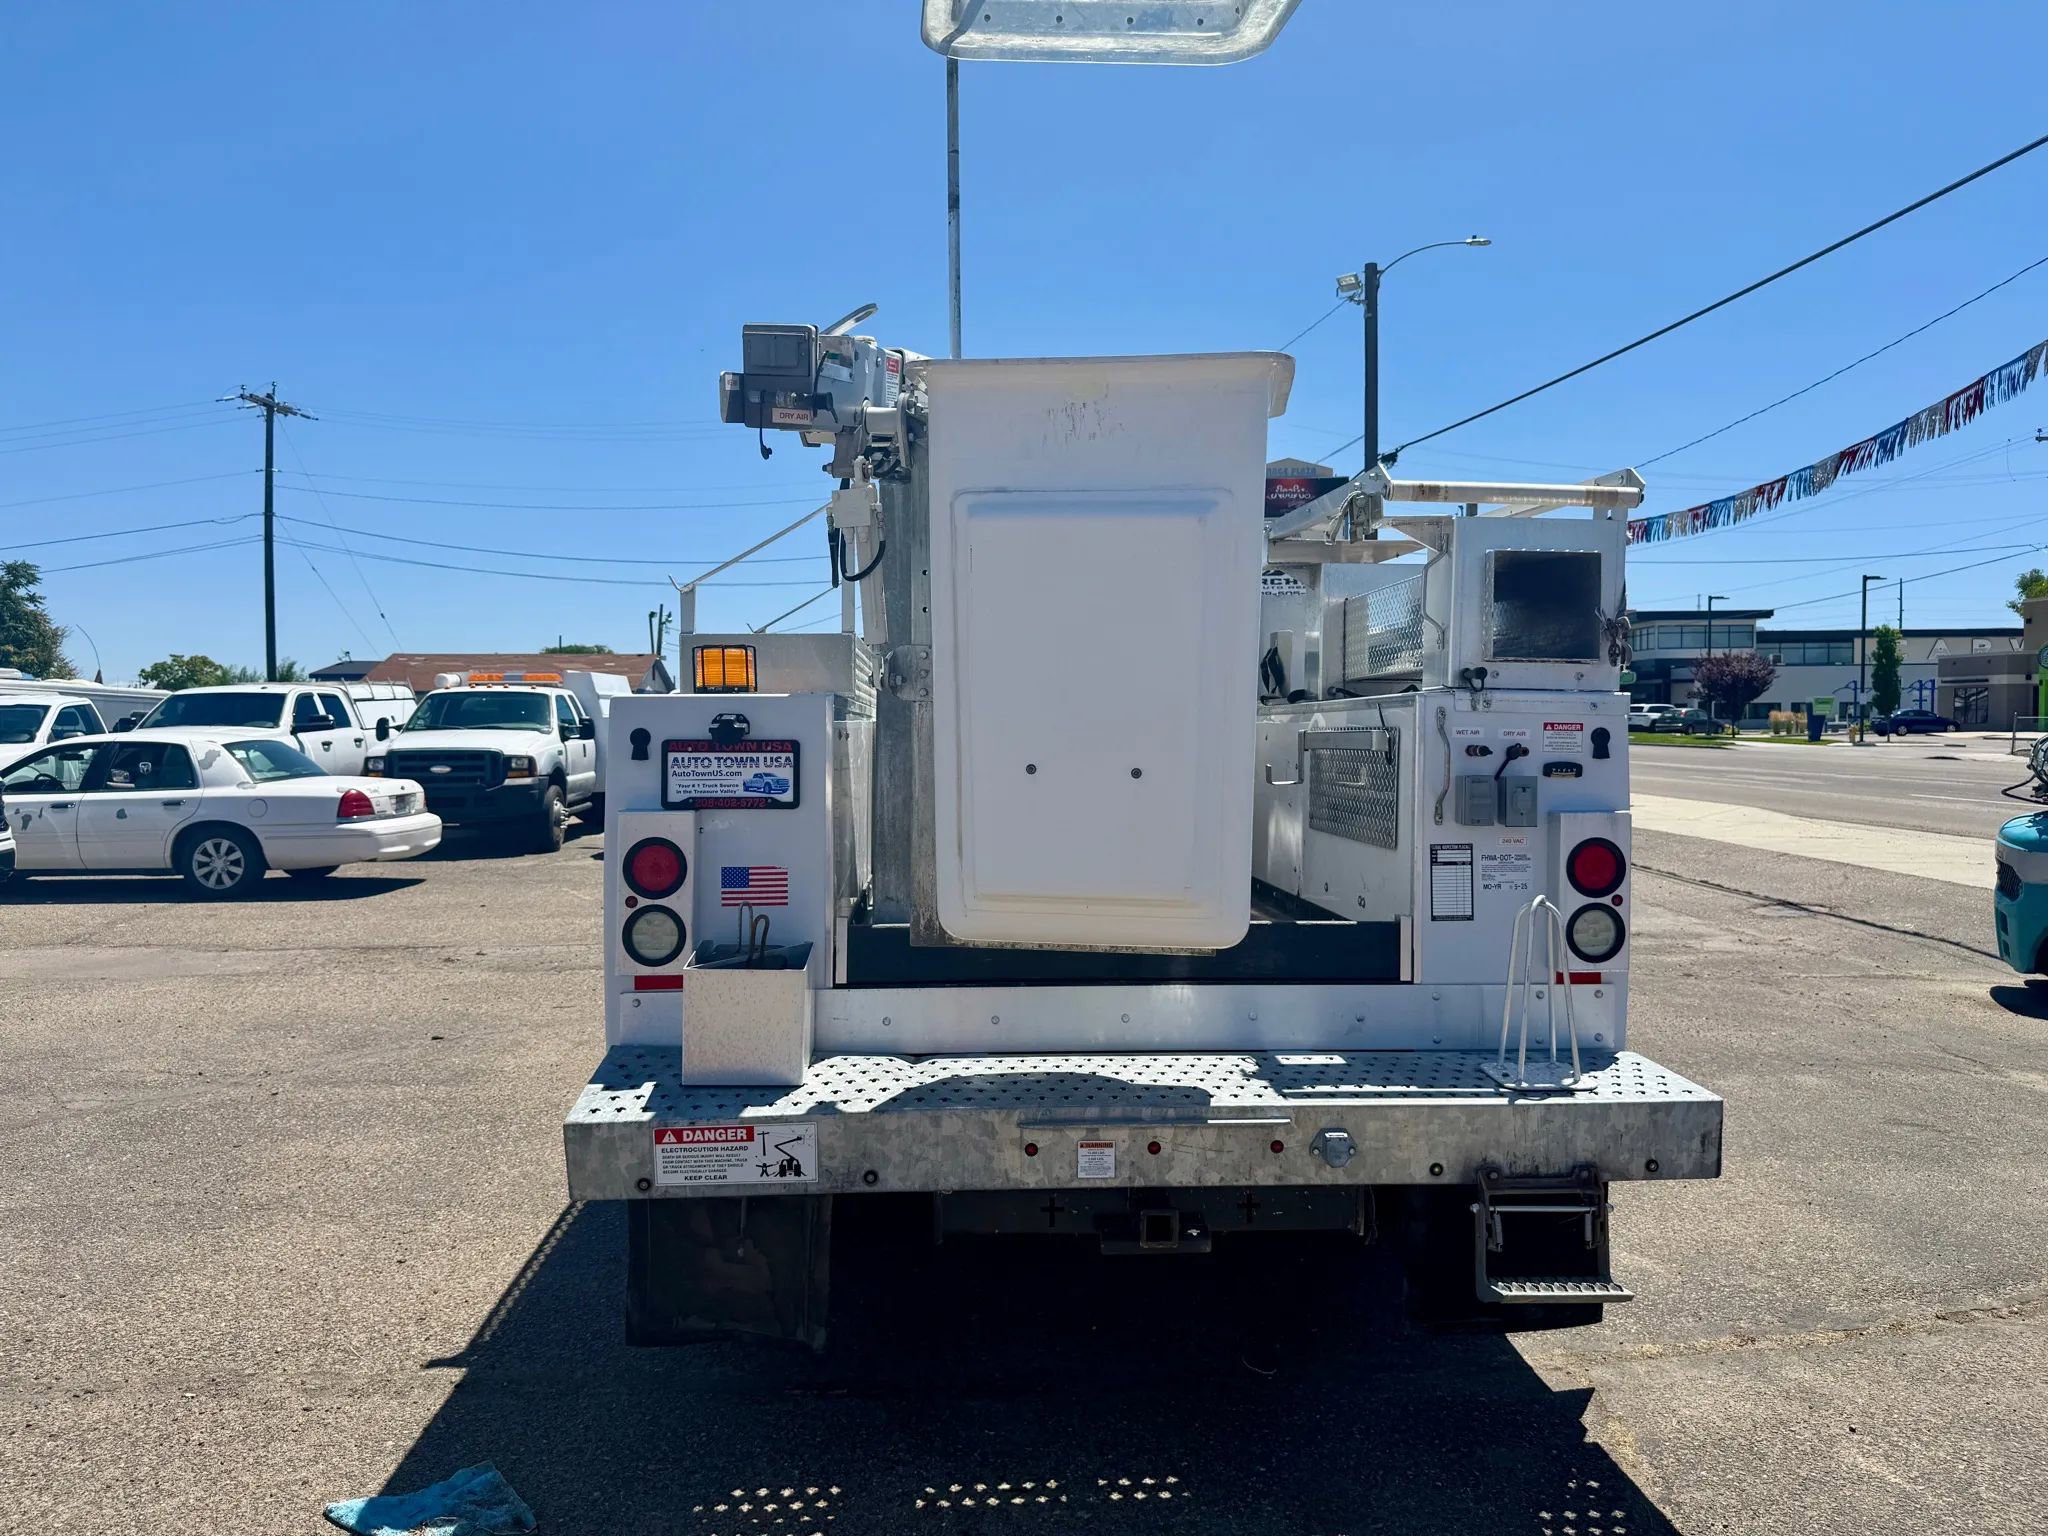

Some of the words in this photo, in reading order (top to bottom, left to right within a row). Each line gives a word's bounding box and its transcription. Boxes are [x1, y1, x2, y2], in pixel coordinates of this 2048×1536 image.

[779, 412, 794, 420] DRY
[795, 412, 809, 421] AIR
[668, 741, 708, 752] AUTO
[762, 741, 793, 752] USA
[671, 756, 712, 769] AUTO
[713, 756, 760, 769] TOWN
[763, 756, 793, 769] USA
[671, 769, 743, 778] AutoTownUS.com
[682, 1129, 747, 1142] DANGER
